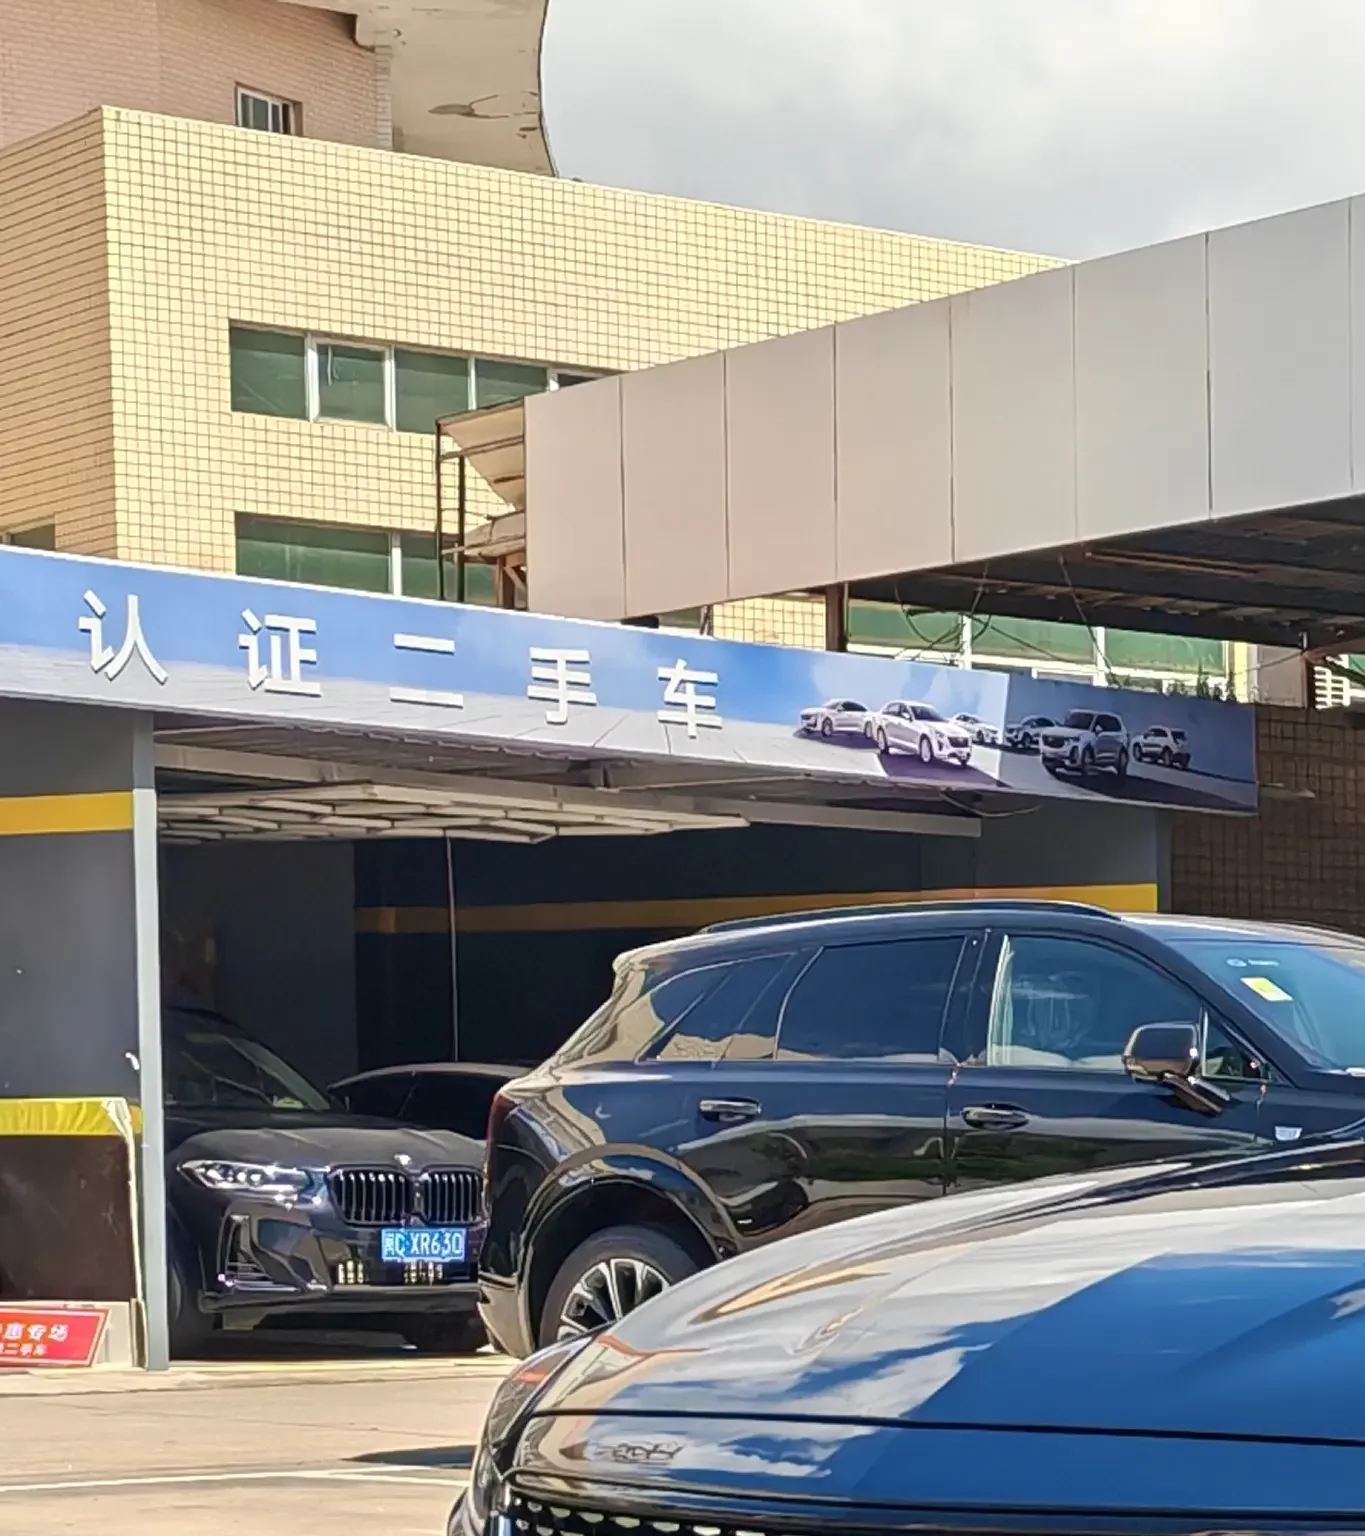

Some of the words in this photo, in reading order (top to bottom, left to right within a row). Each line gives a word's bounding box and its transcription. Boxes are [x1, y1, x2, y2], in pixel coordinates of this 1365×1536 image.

[78, 589, 723, 738] 认证二手车
[0, 1321, 69, 1343] 惠专场
[0, 1342, 48, 1357] 二手车
